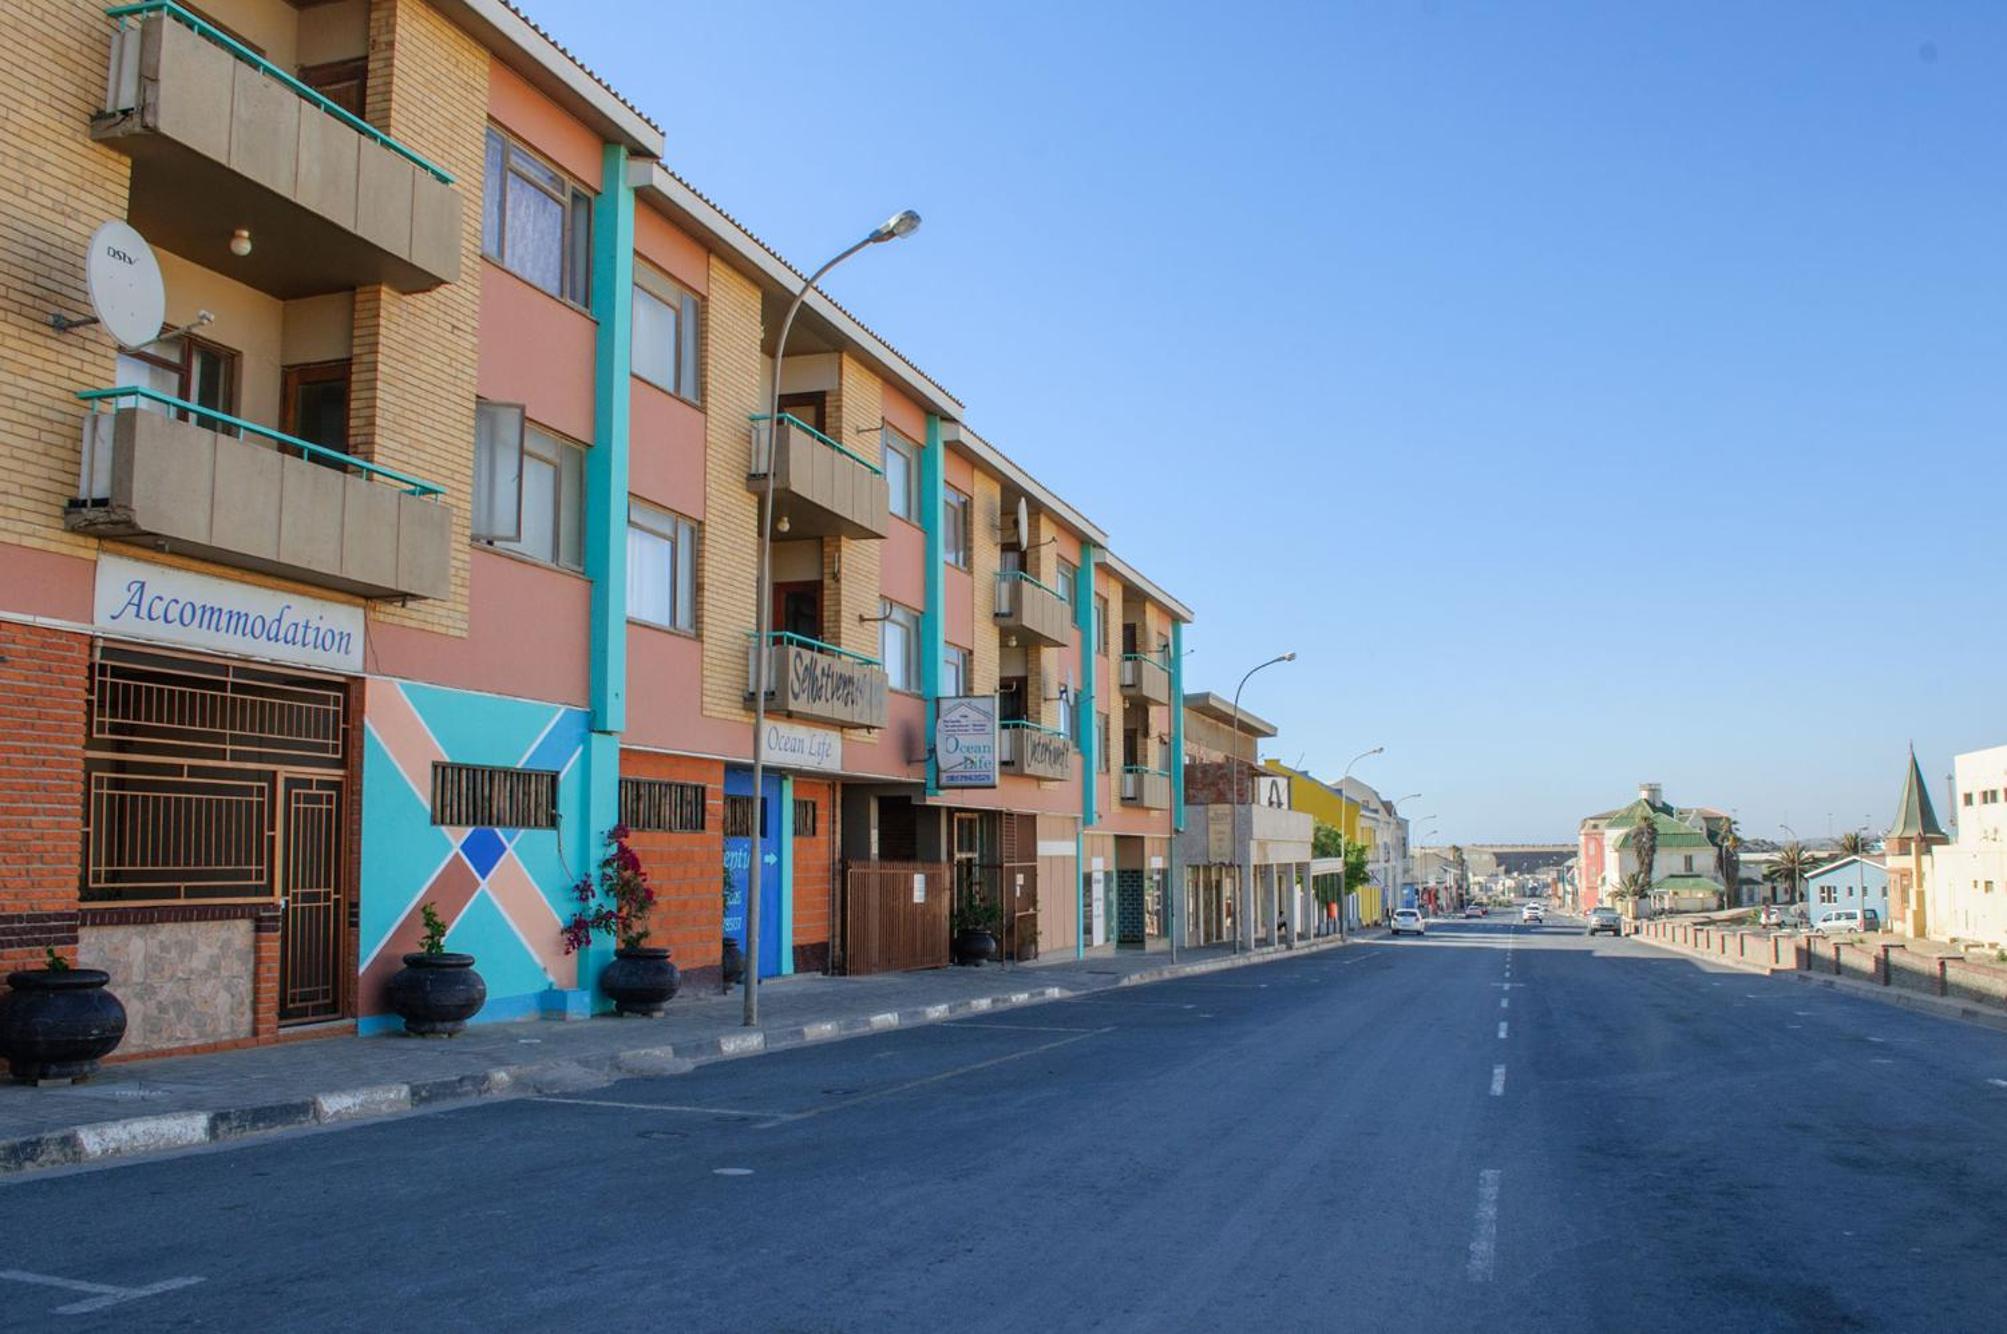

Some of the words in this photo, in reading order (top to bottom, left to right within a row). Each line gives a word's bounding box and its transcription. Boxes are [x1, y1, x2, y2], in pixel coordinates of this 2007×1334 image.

[110, 579, 352, 656] Accommodation
[767, 726, 805, 754] Ocean
[808, 732, 832, 765] Life
[945, 735, 992, 755] Ocean
